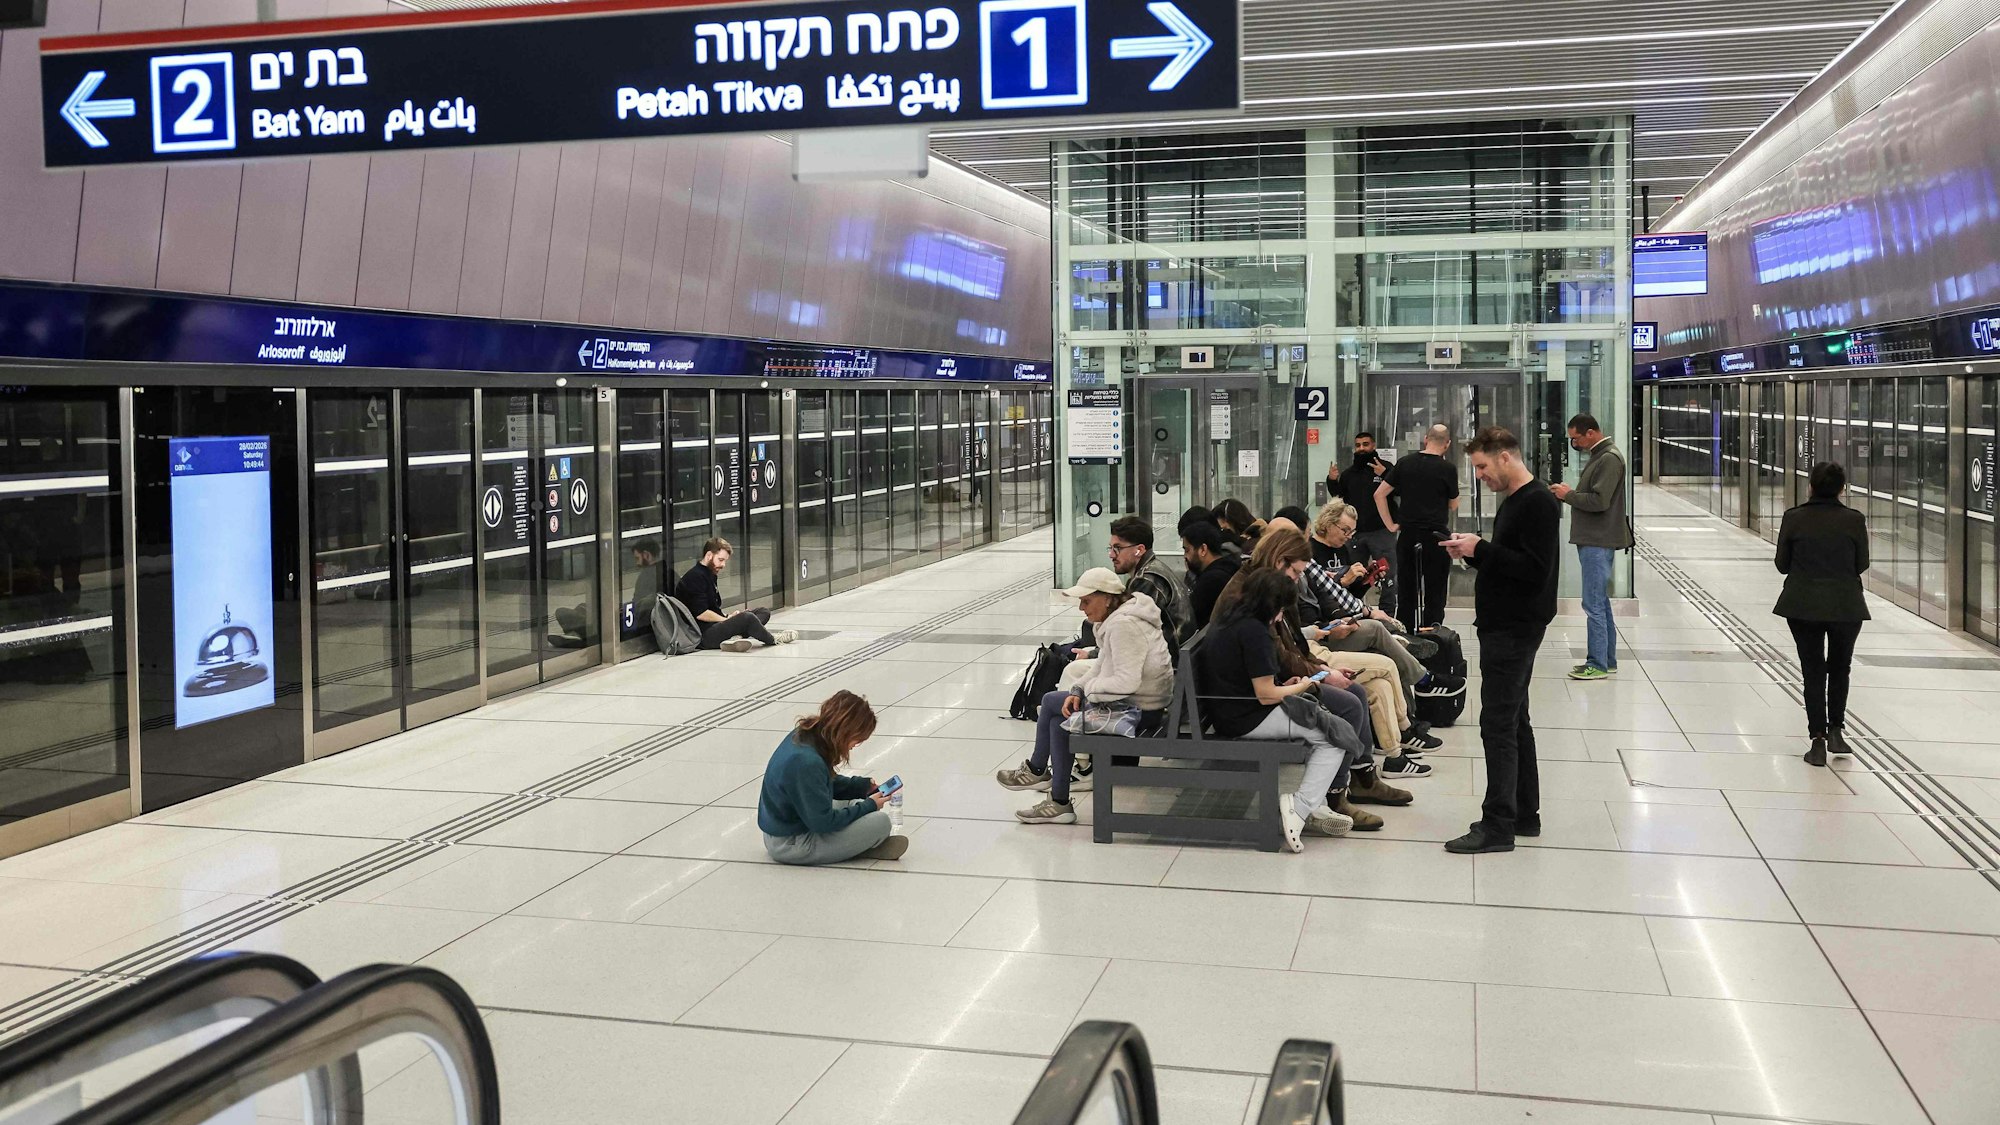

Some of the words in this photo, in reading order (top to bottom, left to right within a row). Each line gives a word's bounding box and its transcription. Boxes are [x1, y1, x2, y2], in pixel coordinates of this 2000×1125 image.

[695, 16, 832, 71] תקווה
[846, 7, 960, 55] פתח
[304, 46, 368, 88] בת
[1011, 16, 1047, 90] 1
[250, 51, 294, 91] ים
[172, 68, 214, 136] 2
[429, 96, 477, 134] بات
[617, 84, 709, 120] Petah
[713, 80, 804, 114] Tikva
[252, 108, 301, 139] Bat
[304, 104, 365, 136] Yam
[384, 99, 425, 142] يام
[274, 315, 336, 338] ארלוזורוב
[1982, 323, 1990, 345] 1
[258, 344, 306, 359] Arlosoroff
[596, 343, 606, 364] 2
[601, 390, 607, 399] 5
[785, 390, 791, 398] 6
[1298, 389, 1325, 417] -2
[243, 451, 264, 460] Saturday
[801, 559, 808, 579] 6
[625, 603, 633, 628] 5
